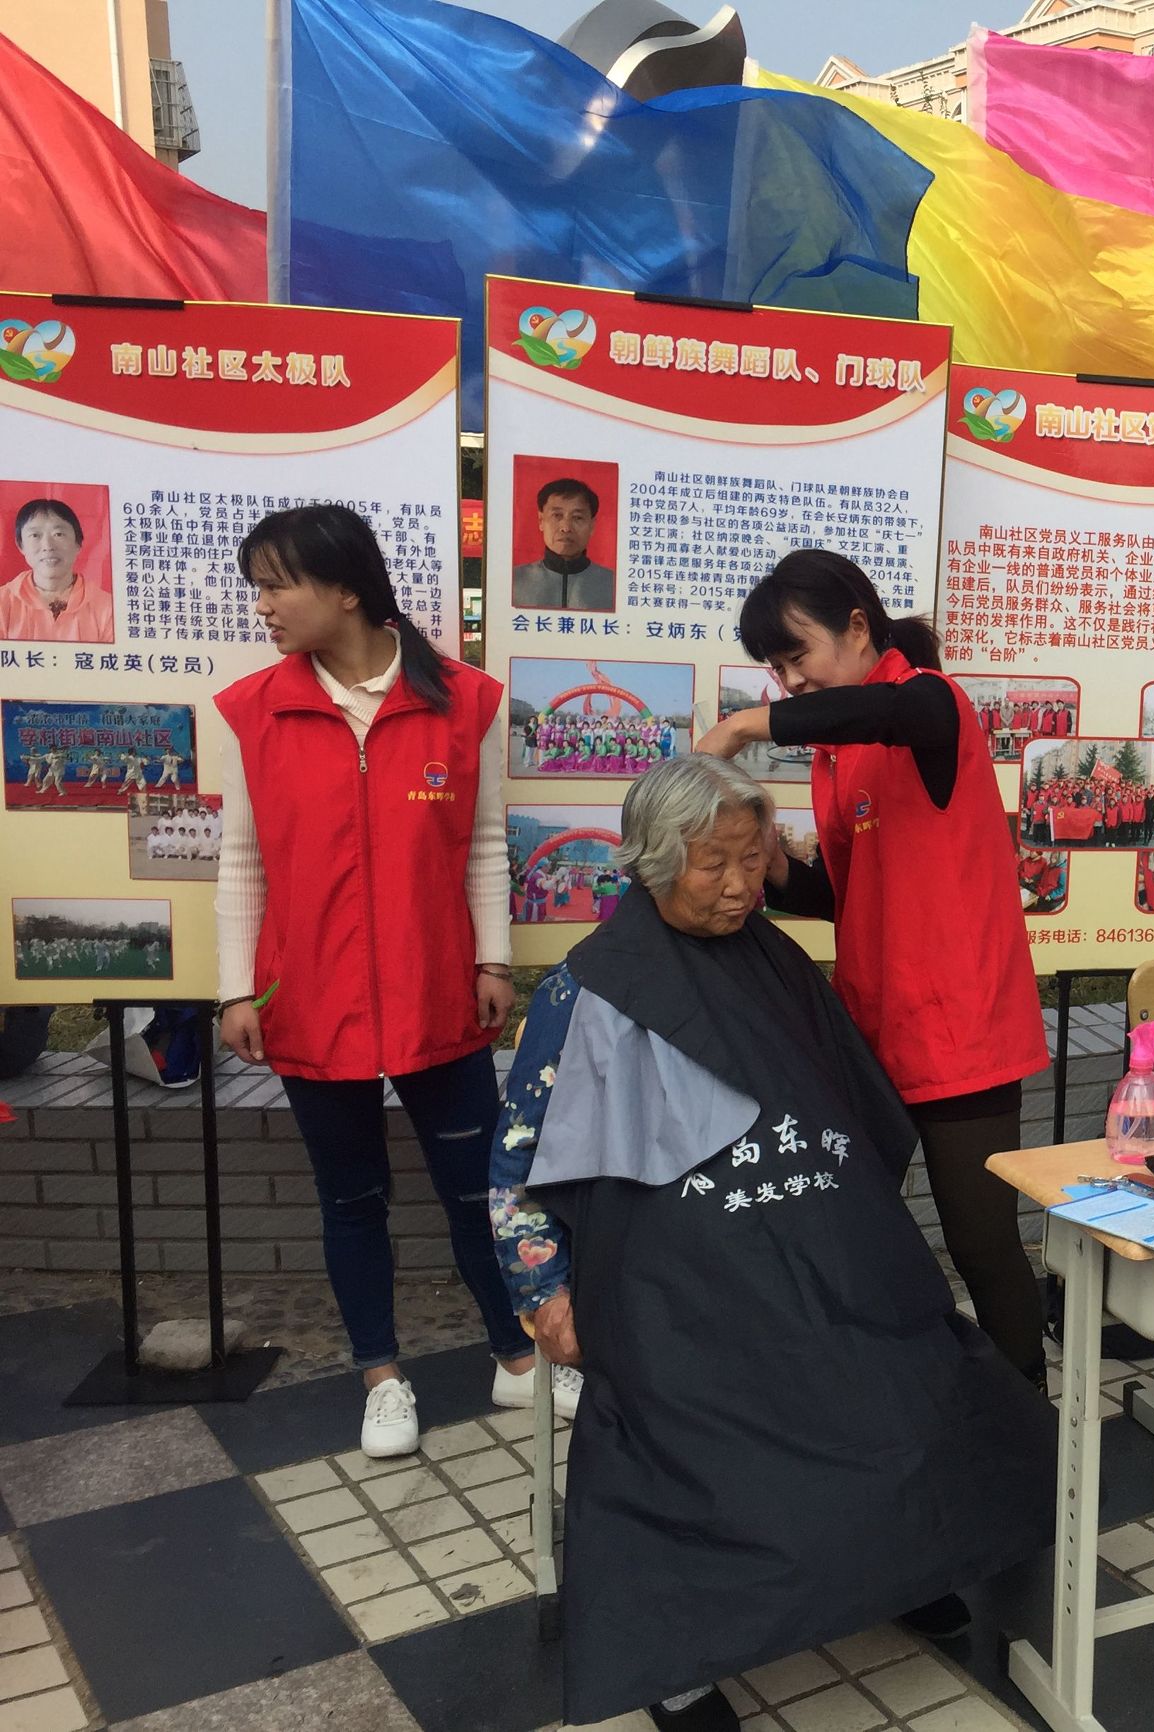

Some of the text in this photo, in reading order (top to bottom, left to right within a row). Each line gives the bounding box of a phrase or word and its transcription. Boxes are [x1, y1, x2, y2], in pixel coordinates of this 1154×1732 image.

[110, 343, 351, 388] 南山社区太极队
[608, 331, 926, 393] 朝鲜族舞蹈队、门球队
[724, 1171, 840, 1213] 美发学校
